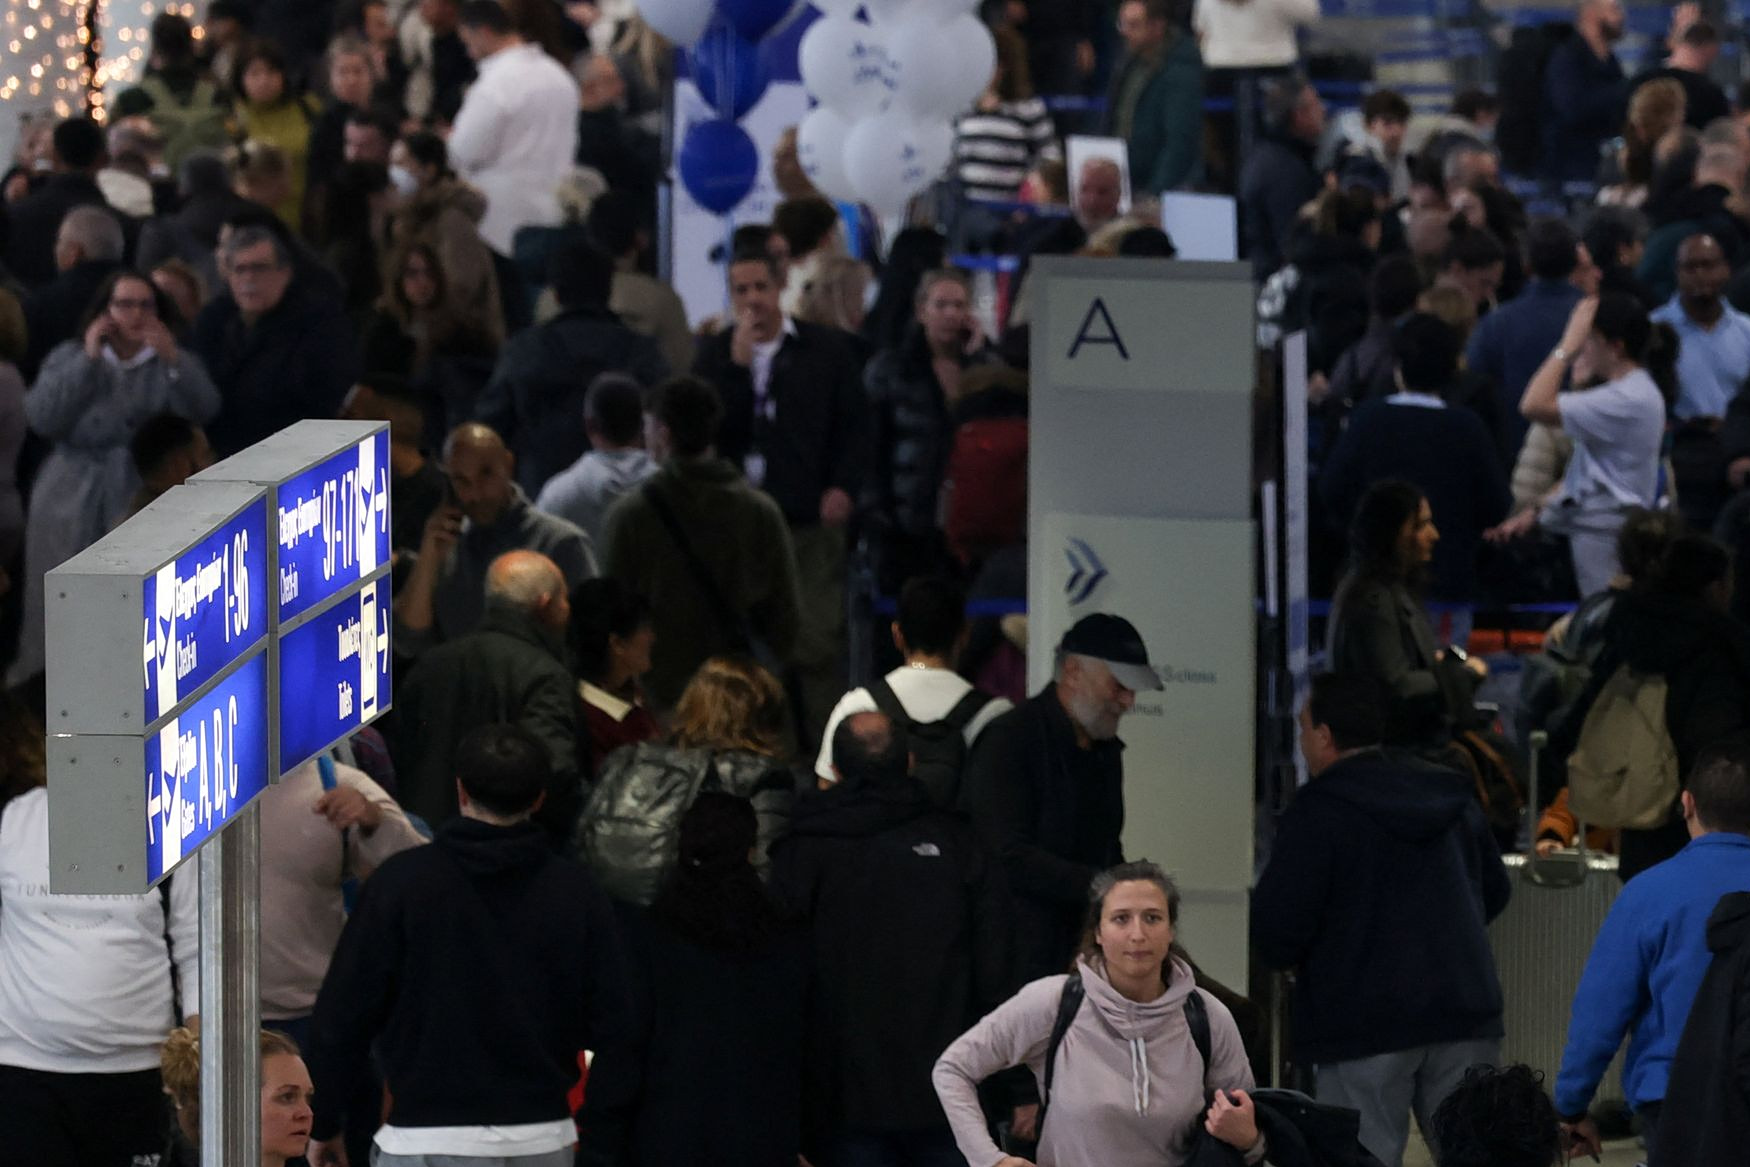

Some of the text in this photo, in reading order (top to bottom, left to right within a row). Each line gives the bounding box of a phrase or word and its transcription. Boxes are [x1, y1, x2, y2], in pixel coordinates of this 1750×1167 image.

[1067, 297, 1130, 361] A
[322, 466, 360, 581] 97-171
[223, 528, 250, 643] 1-96
[228, 694, 238, 799] C
